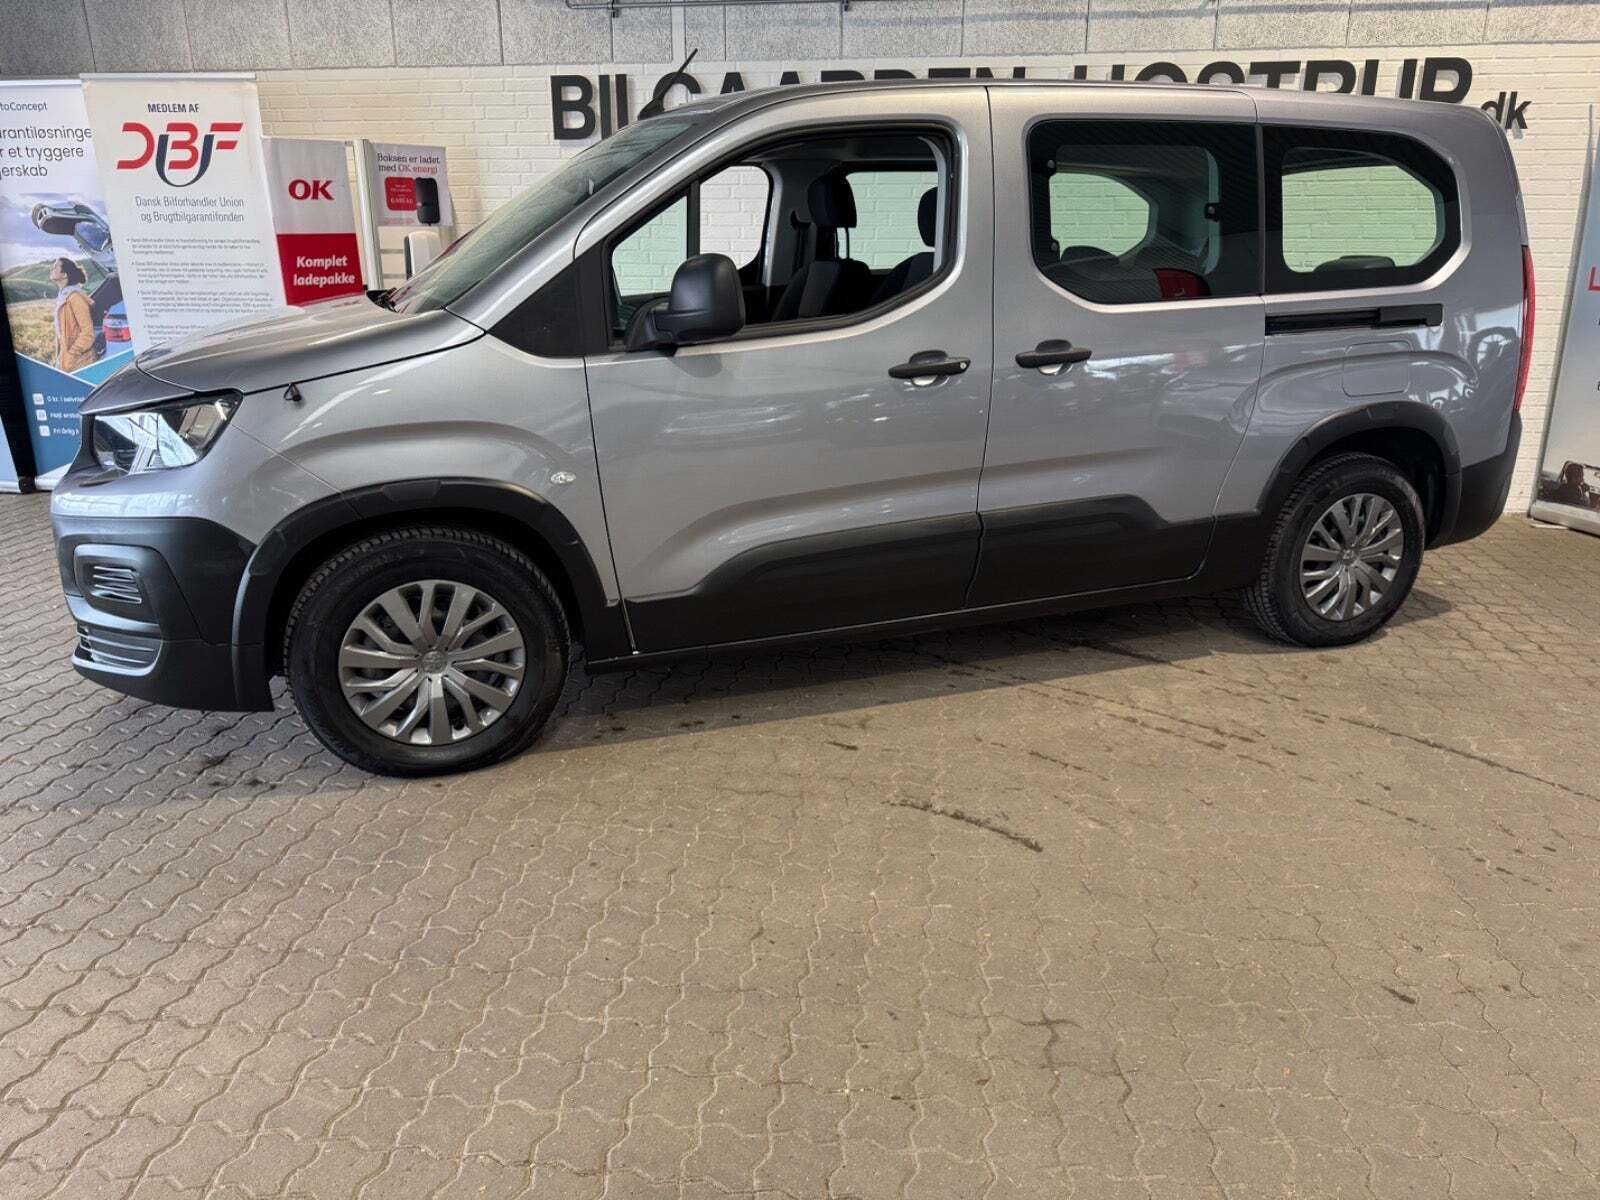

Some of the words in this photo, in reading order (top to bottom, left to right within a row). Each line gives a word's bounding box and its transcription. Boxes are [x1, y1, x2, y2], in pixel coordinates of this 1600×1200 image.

[147, 103, 187, 113] MEDLEM
[188, 103, 200, 113] AF
[0, 125, 92, 142] rantiløsninge
[8, 146, 22, 158] et
[25, 146, 84, 162] tryggere
[377, 152, 407, 163] Boksen
[408, 156, 418, 164] er
[419, 156, 441, 164] ladet
[0, 164, 48, 180] erskab
[378, 164, 397, 172] med
[398, 164, 412, 172] OK
[288, 179, 334, 201] OK
[135, 196, 161, 207] Dansk
[163, 196, 218, 207] Bilforhandler
[219, 196, 244, 208] Union
[141, 213, 152, 223] og
[153, 211, 244, 224] Brugtbilgarantifonden
[296, 255, 348, 270] Komplet
[293, 273, 355, 288] ladepakke
